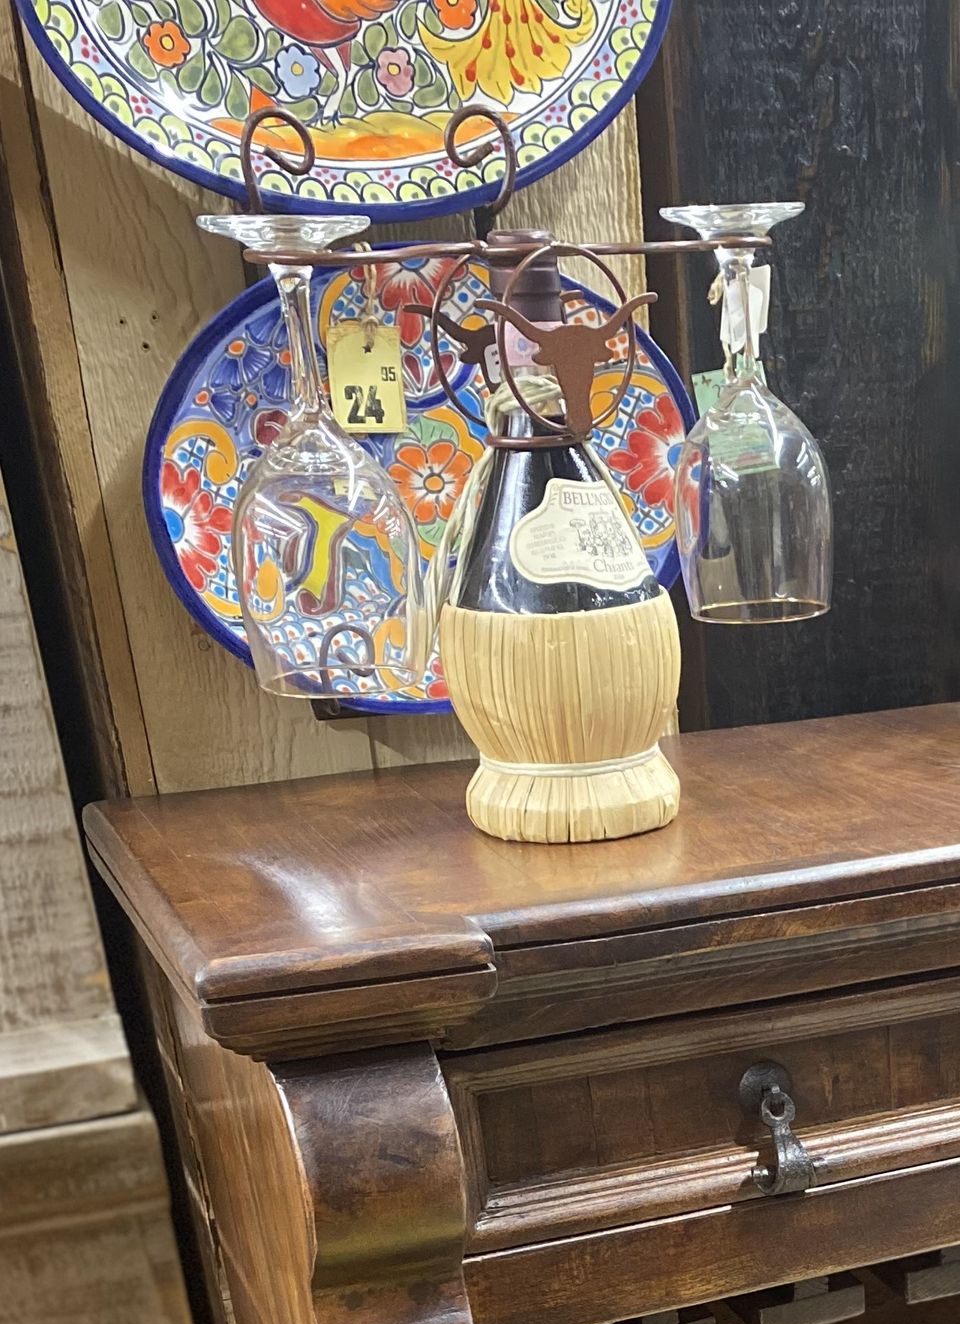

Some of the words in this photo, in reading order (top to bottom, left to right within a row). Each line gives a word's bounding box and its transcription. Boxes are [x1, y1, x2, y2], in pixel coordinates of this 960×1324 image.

[381, 366, 396, 381] 95
[344, 385, 385, 424] 24
[593, 558, 634, 573] Chianti
